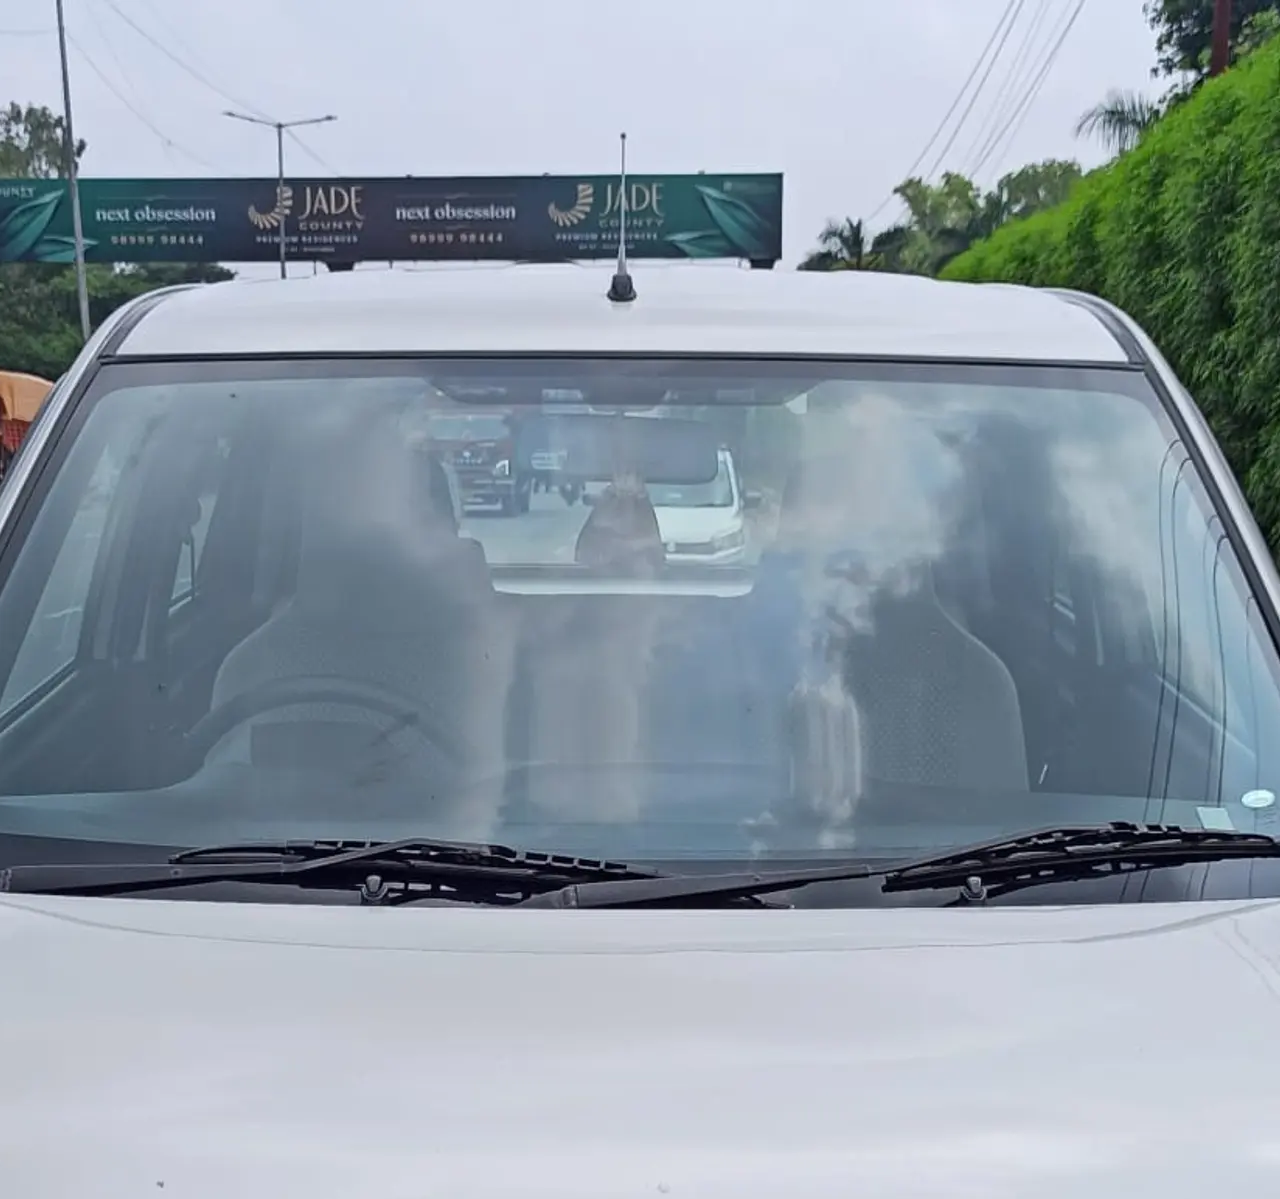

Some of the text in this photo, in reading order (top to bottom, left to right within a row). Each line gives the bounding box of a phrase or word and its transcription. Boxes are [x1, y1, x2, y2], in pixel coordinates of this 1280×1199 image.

[297, 185, 366, 220] JADE
[395, 201, 517, 221] next obsession
[95, 204, 217, 222] next obsession
[298, 221, 364, 231] COUNTY
